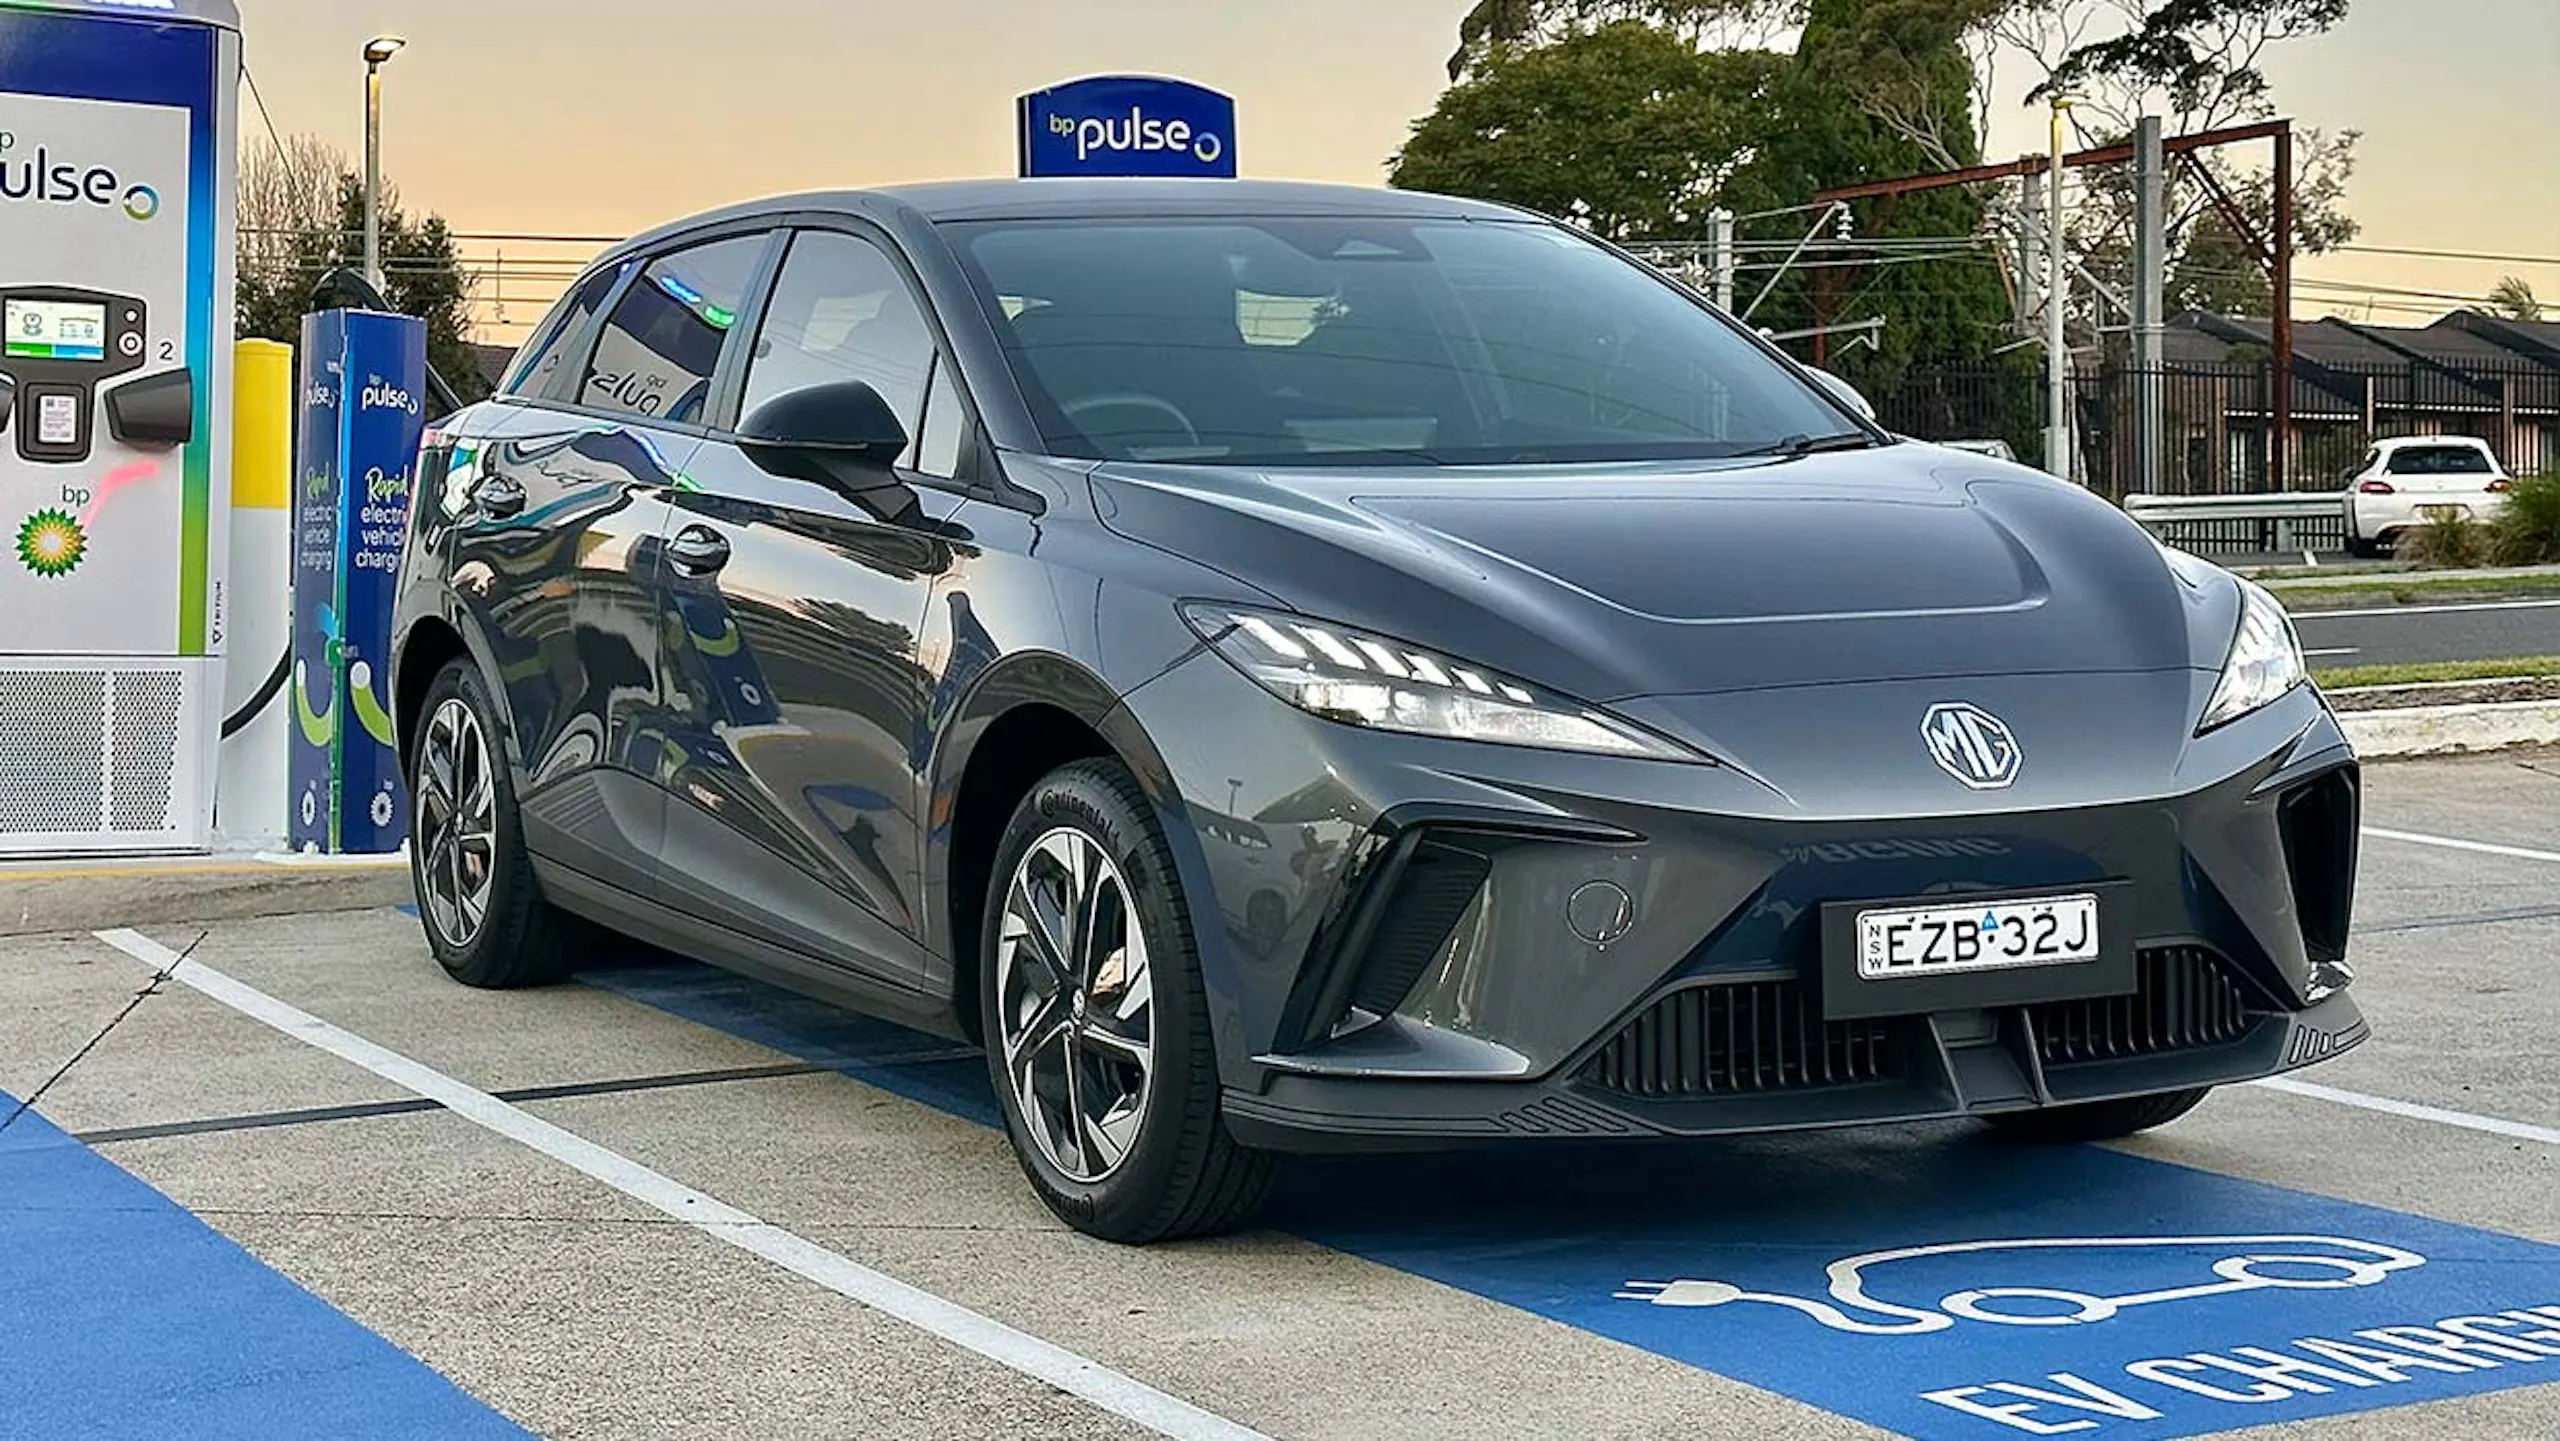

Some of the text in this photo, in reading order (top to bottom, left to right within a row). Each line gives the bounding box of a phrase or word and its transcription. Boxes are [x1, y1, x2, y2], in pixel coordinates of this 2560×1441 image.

[0, 132, 15, 152] p
[1050, 105, 1191, 160] bp pulse
[0, 147, 117, 204] ulse
[159, 340, 174, 361] 2
[362, 381, 409, 411] pulse
[62, 483, 90, 507] bp
[365, 463, 409, 503] Rapid
[1930, 709, 2013, 779] MG
[1919, 1371, 2164, 1435] EV
